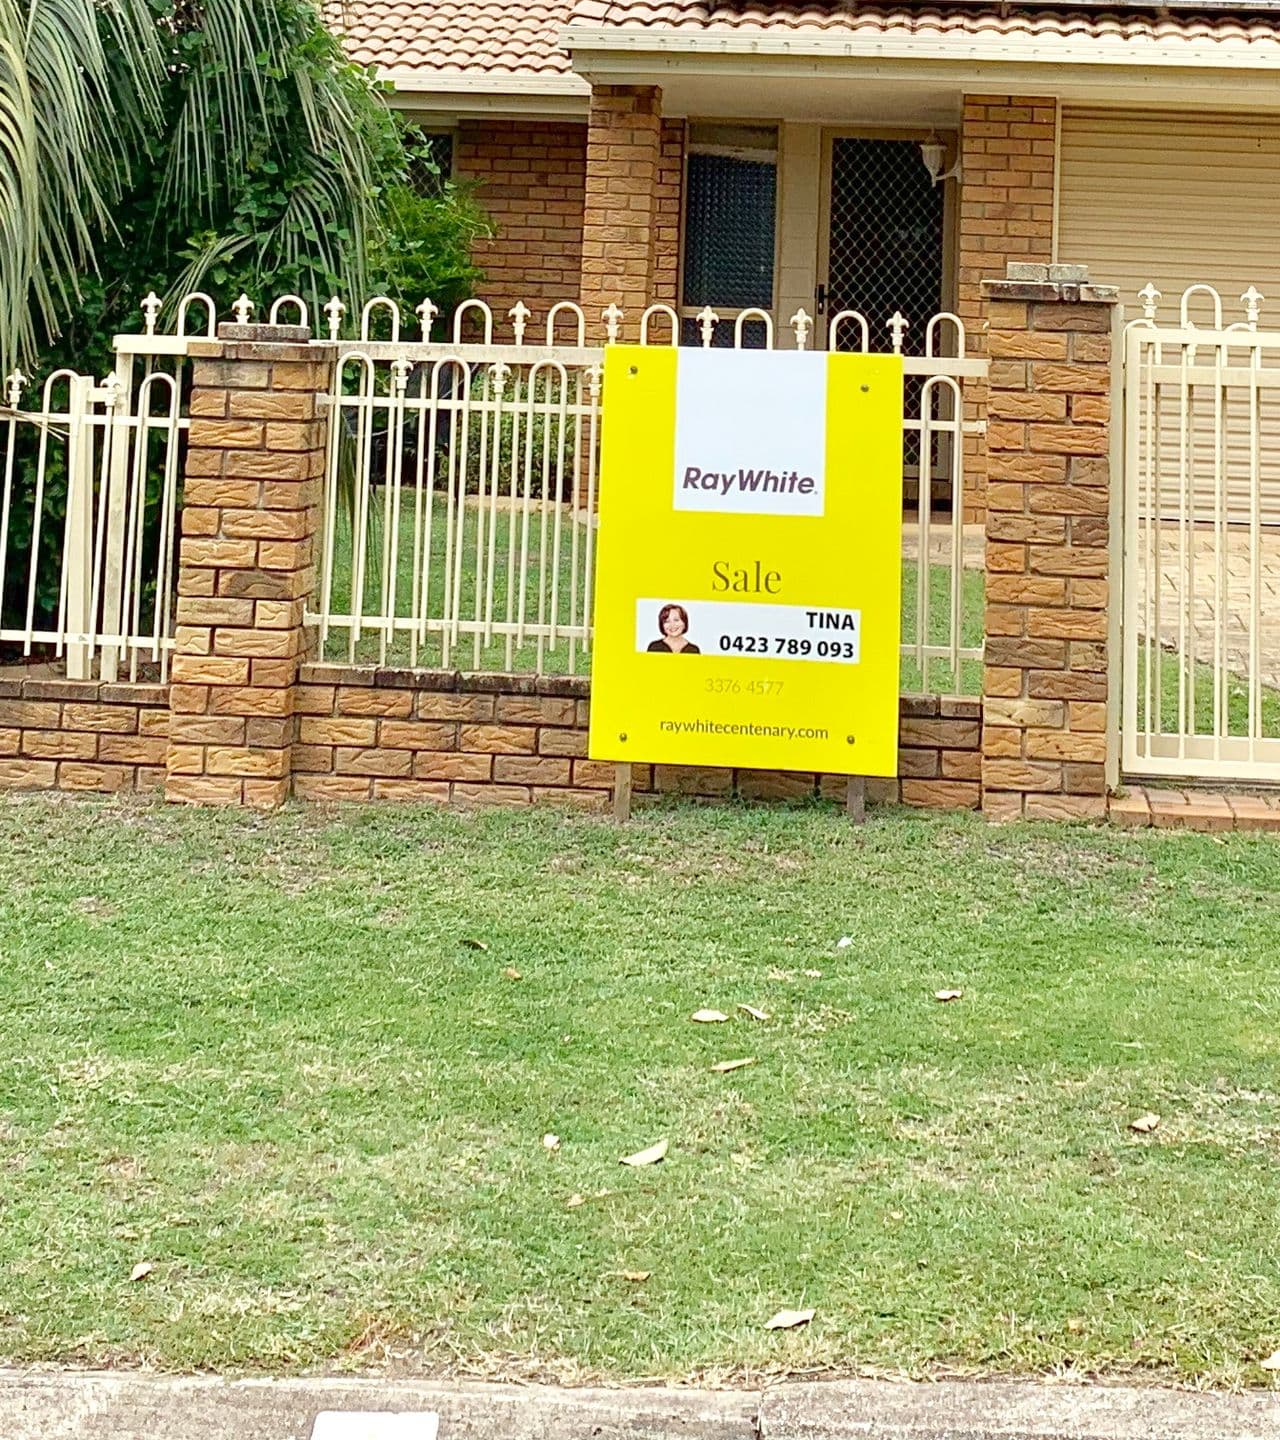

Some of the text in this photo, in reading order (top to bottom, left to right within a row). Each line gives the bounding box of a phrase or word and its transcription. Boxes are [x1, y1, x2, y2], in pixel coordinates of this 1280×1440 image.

[712, 561, 782, 594] Sale
[806, 611, 855, 631] TINA
[720, 635, 854, 659] 0423 789 093
[705, 678, 784, 696] 3376 4577
[660, 718, 829, 740] raywhitecentenary.com
